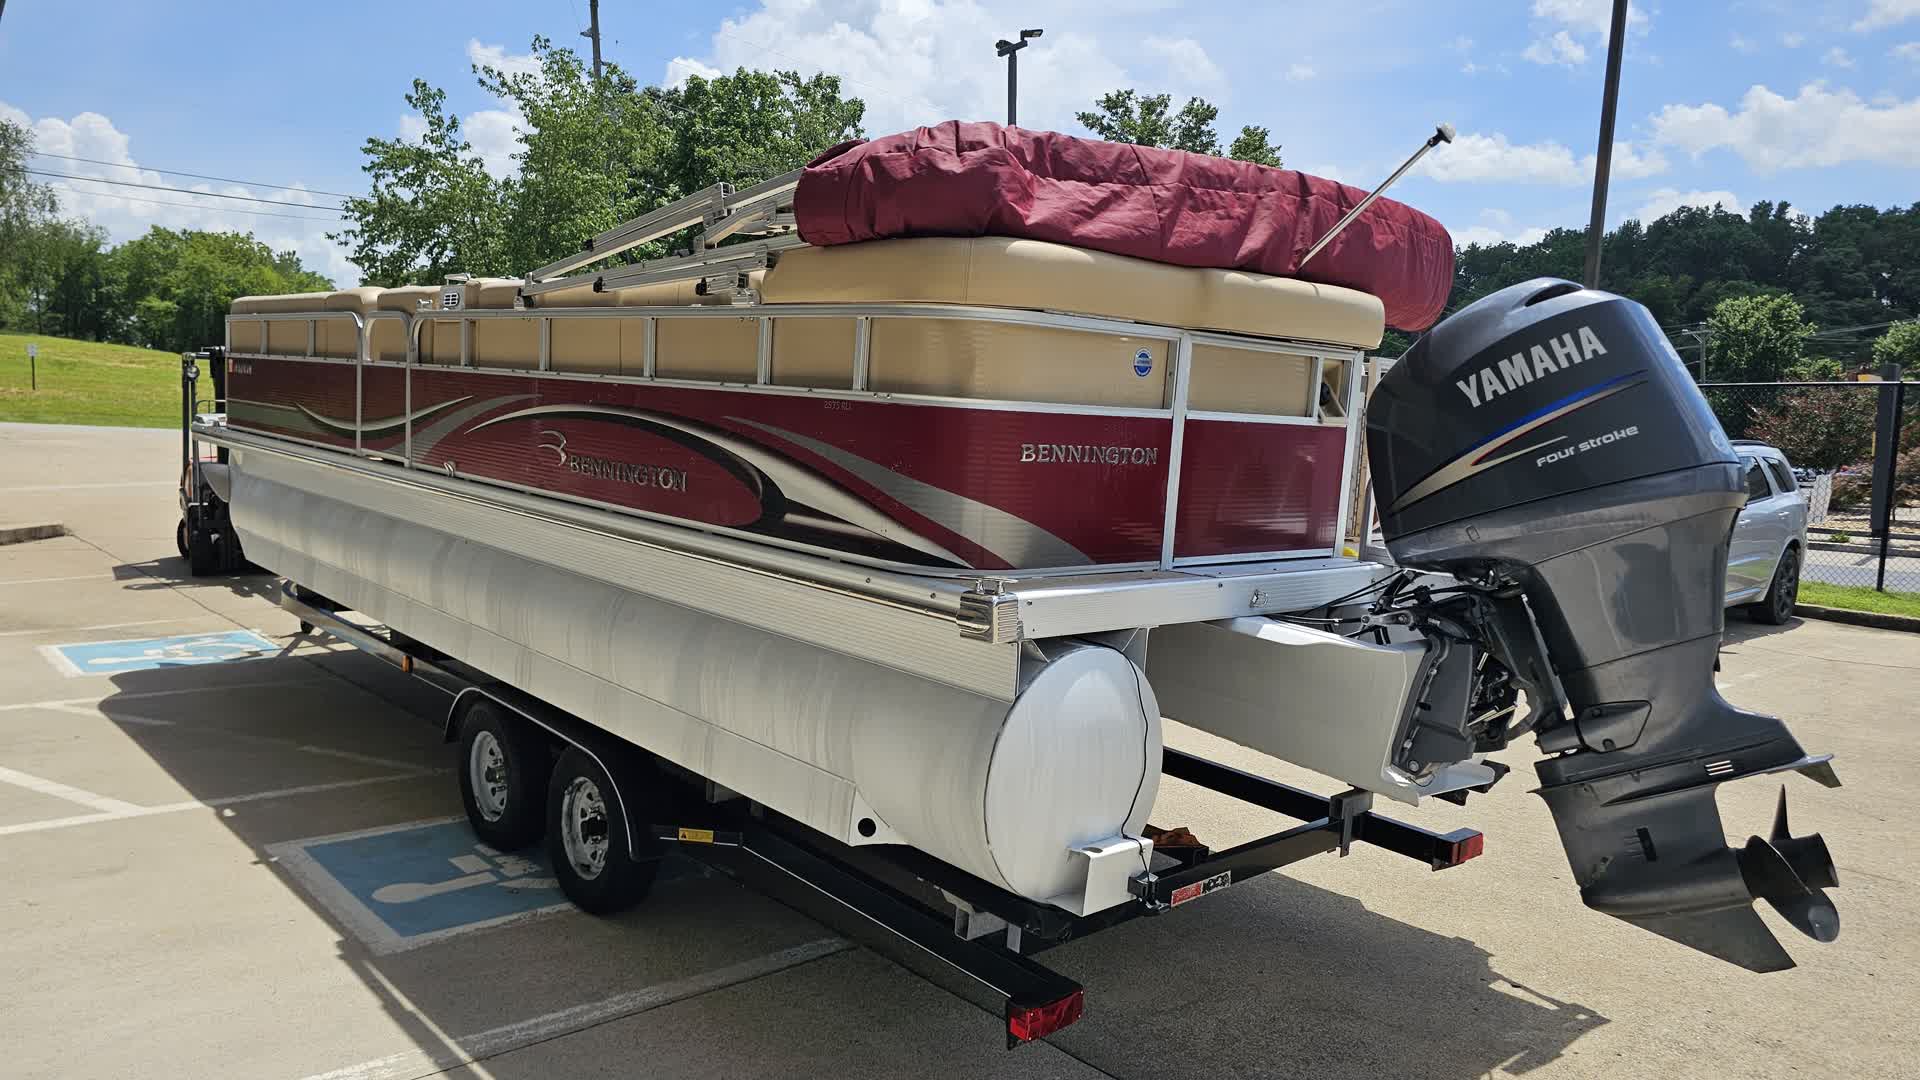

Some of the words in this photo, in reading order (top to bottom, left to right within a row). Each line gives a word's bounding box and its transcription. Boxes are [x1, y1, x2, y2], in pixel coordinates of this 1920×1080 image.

[1456, 326, 1607, 408] YAMAHA
[1020, 443, 1158, 465] BENNINGTON
[569, 455, 687, 492] BENNINGTON
